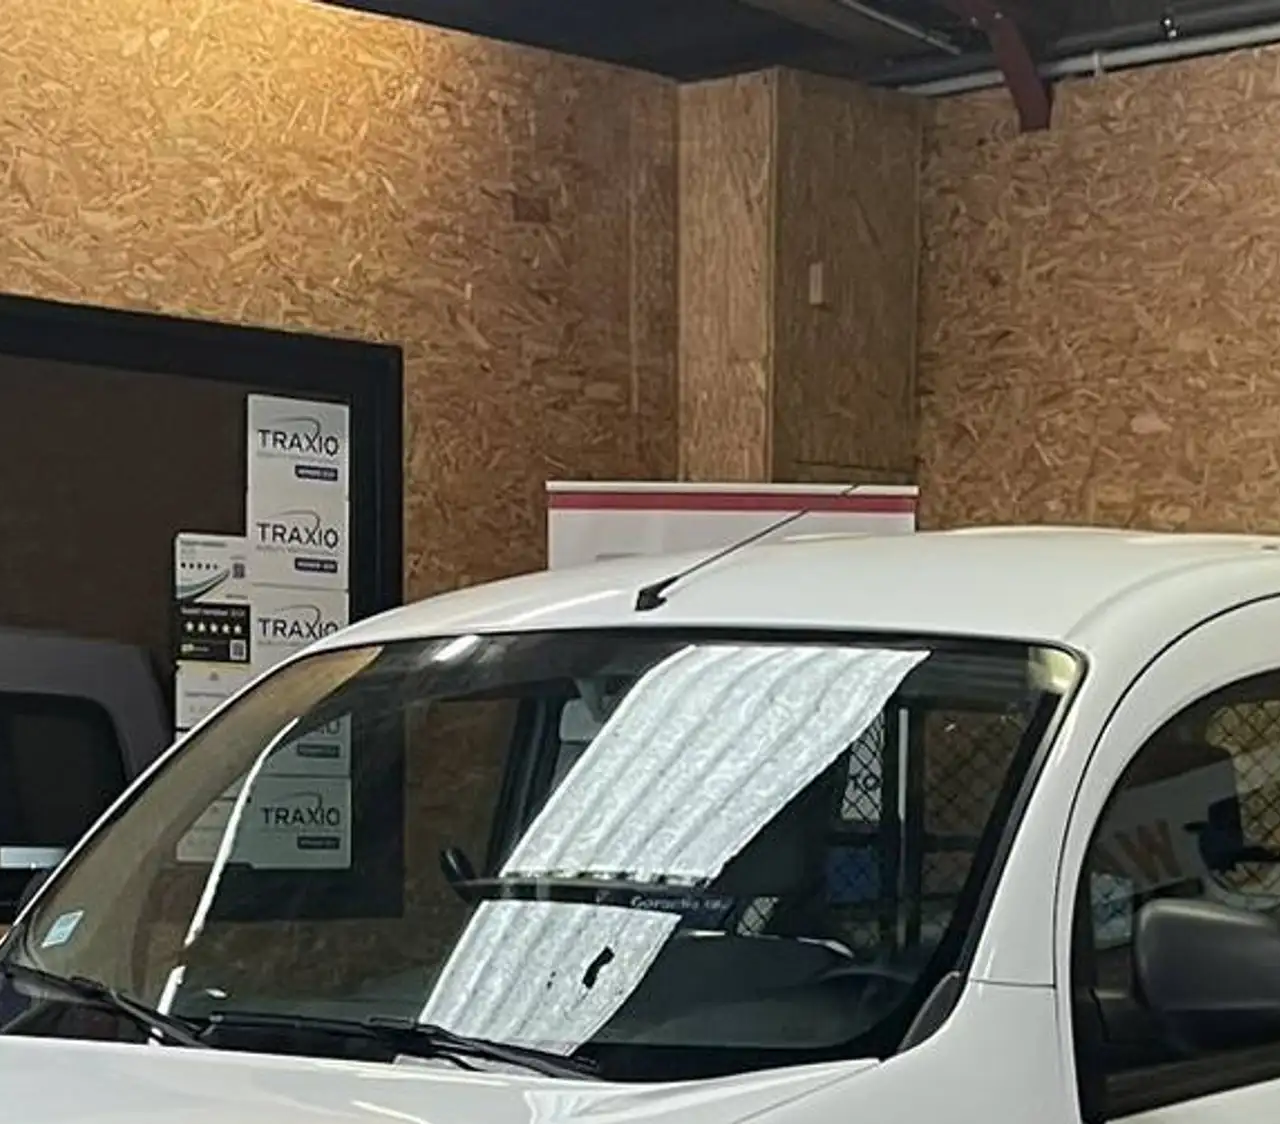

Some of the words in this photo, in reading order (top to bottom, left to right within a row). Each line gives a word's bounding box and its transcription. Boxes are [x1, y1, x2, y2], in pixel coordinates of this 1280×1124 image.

[258, 429, 339, 457] TRAXIO
[256, 522, 339, 549] TRAXIO
[263, 807, 341, 826] TRAXIO
